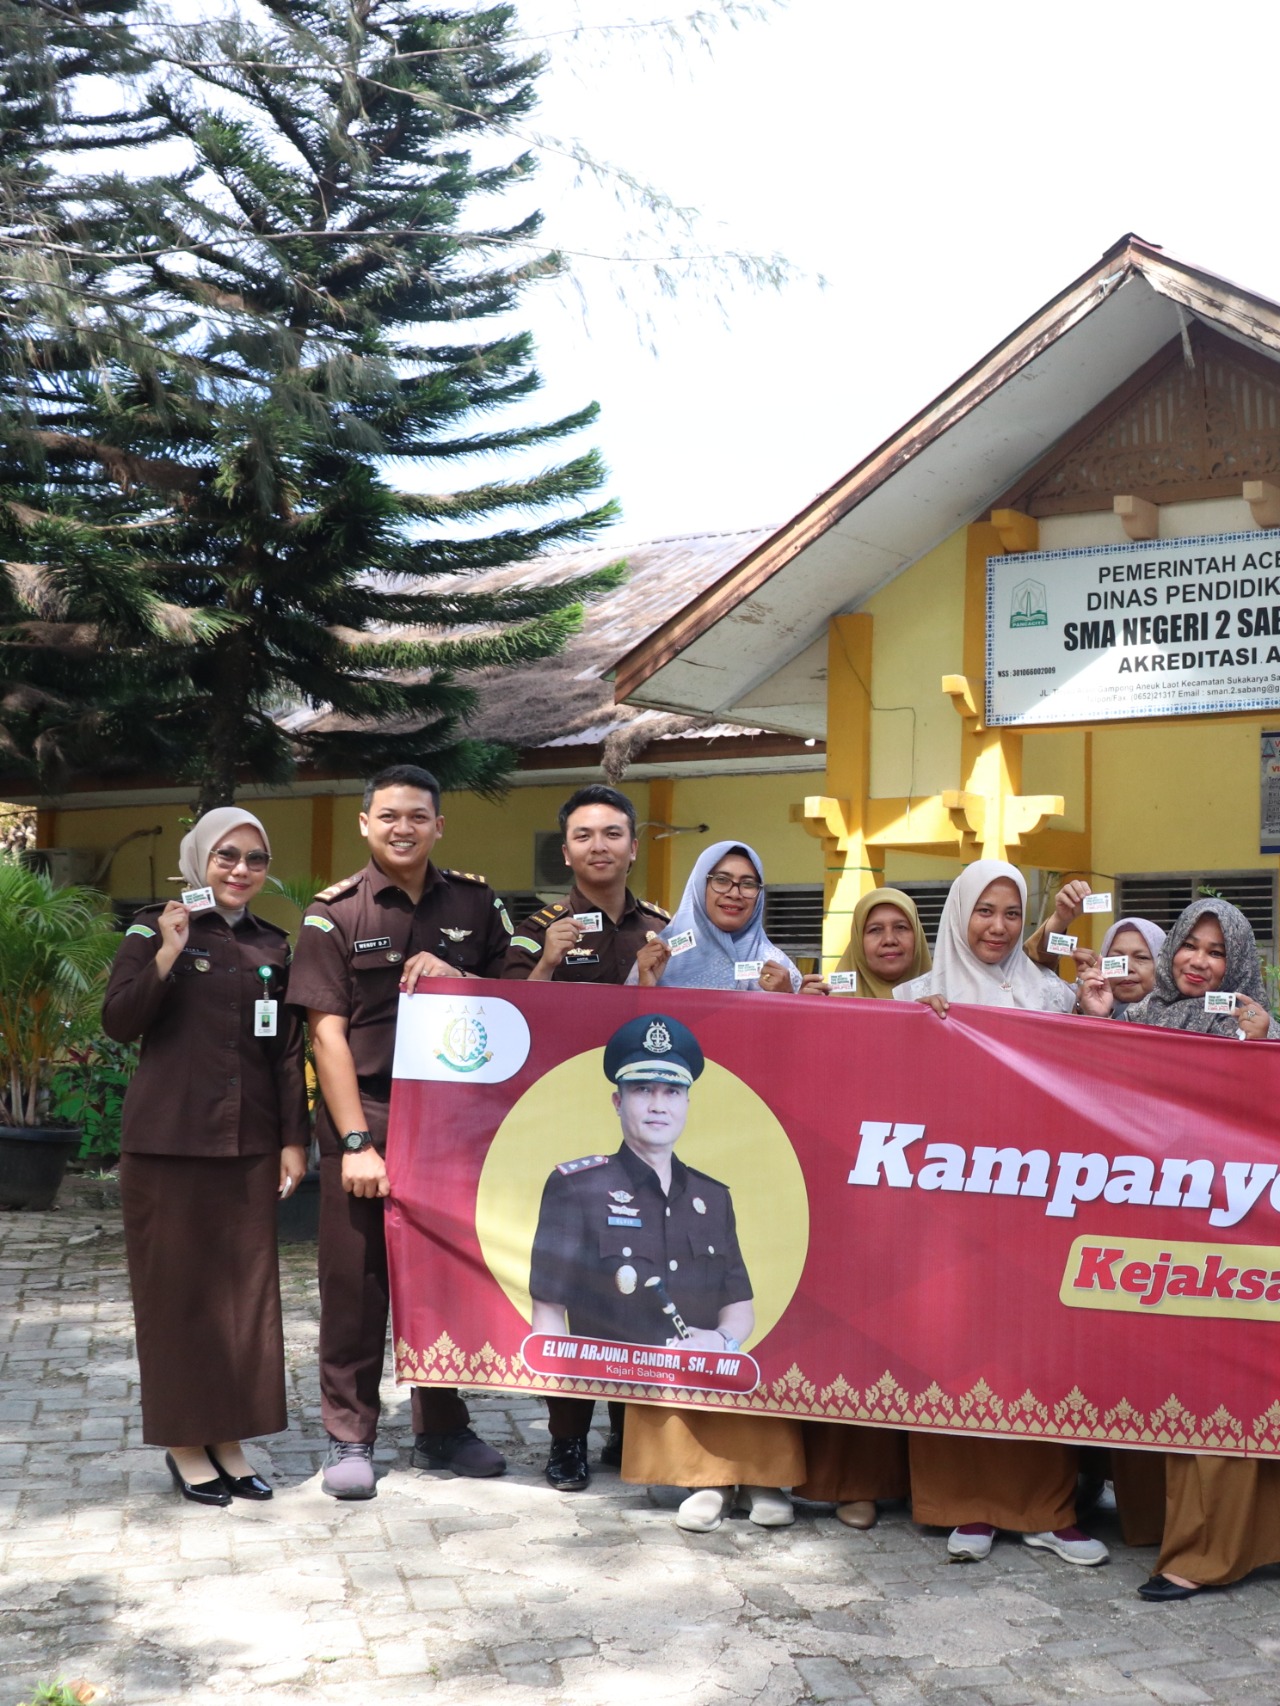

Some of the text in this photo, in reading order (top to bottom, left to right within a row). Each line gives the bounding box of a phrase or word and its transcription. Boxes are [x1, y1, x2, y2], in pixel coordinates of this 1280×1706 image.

[1099, 555, 1236, 584] PEMERINTAH
[1087, 587, 1158, 611] DINAS
[1064, 619, 1116, 651] SMA
[1123, 612, 1209, 647] NEGERI
[1215, 610, 1230, 640] 2
[1118, 648, 1257, 674] AKREDITASI
[1162, 681, 1179, 689] Laot
[1181, 678, 1225, 688] Kecamatan
[1227, 674, 1269, 685] Sukakarya
[1178, 689, 1200, 698] Email
[542, 1340, 577, 1359] ELVIN
[580, 1343, 629, 1364] ARJUNA
[716, 1358, 740, 1376] MH
[606, 1364, 675, 1381] Kajari Sabang
